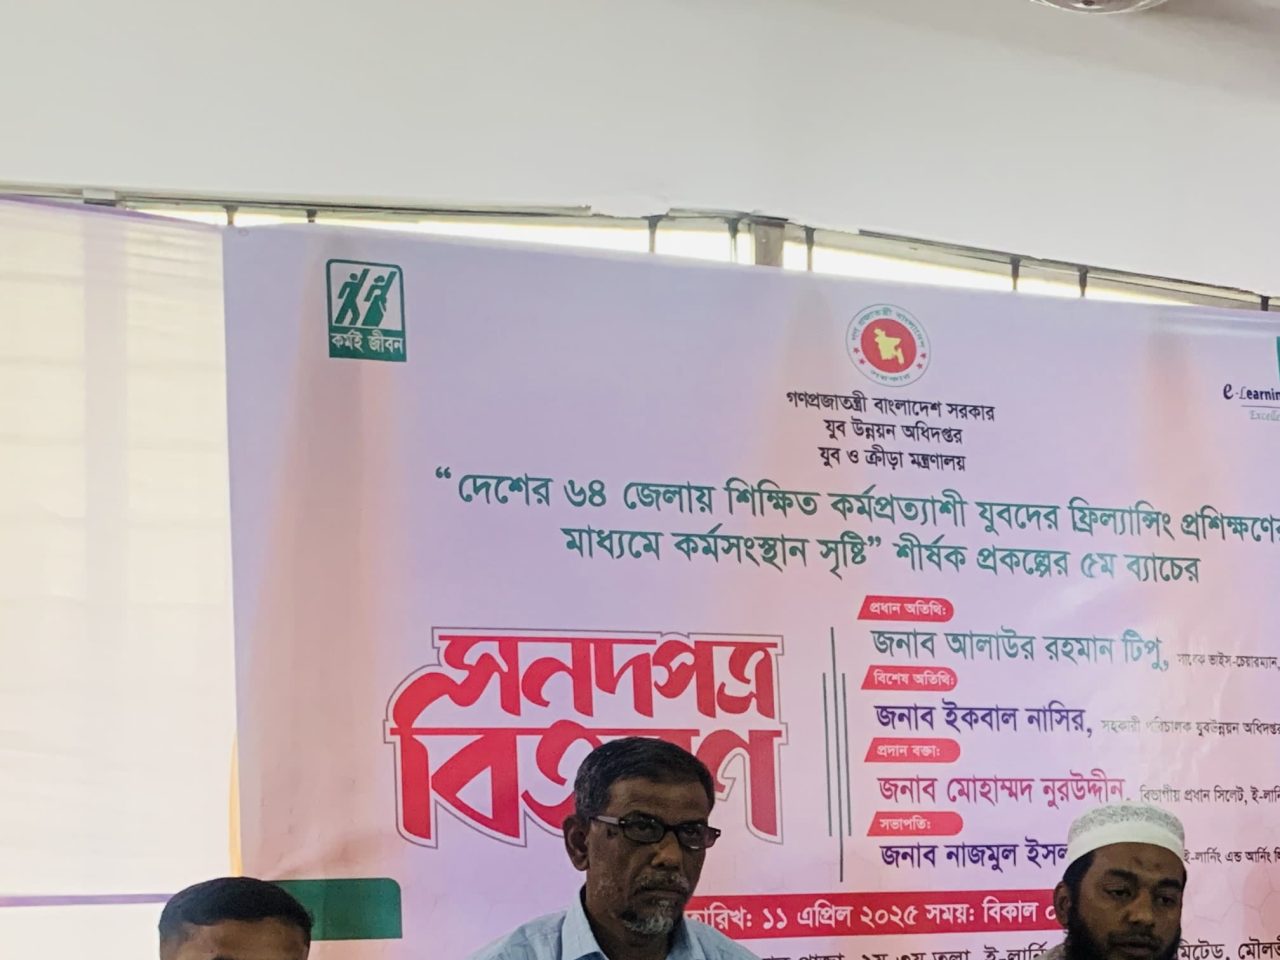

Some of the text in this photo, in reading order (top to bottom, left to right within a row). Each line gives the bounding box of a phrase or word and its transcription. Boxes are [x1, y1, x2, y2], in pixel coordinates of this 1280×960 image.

[330, 329, 403, 354] কর্মই জীবন
[786, 390, 995, 421] গণপ্রজাতন্ত্রী বাংলাদেশ সরকার
[824, 416, 962, 444] যুব উন্নয়ন অধিদপ্তর
[818, 444, 966, 472] যুব ও ক্রীড়া মন্ত্রণালয়
[564, 479, 606, 507] ৬৪
[624, 481, 715, 514] জেলায়
[724, 476, 821, 517] শিক্ষিত
[828, 484, 968, 527] কর্মপ্রত্যাশী
[976, 501, 1060, 536] যুবদের
[1067, 497, 1175, 540] ফ্রিল্যান্সিং
[560, 524, 663, 560] মাধ্যমে
[671, 523, 809, 572] কর্মসংস্থান
[893, 532, 968, 571] শীর্ষক
[977, 545, 1070, 578] প্রকল্পের
[1080, 551, 1117, 578] ৫ম
[1124, 553, 1201, 583] ব্যাচের
[870, 602, 901, 615] প্রধান
[870, 628, 937, 659] জনাব
[944, 625, 1036, 661] আলাউর
[1042, 635, 1116, 663] রহমান
[1121, 628, 1169, 671] টিপু,
[439, 634, 778, 720] সনদপত্র
[874, 671, 909, 686] বিশেষ
[874, 703, 936, 731] জনাব
[942, 698, 1019, 733] ইকবাল
[1025, 700, 1092, 738] নাসির,
[390, 672, 782, 840] বিতণ
[877, 774, 938, 803] জনাব
[946, 774, 1034, 806] মোহাম্মদ
[1184, 788, 1210, 802] প্রধান
[1214, 785, 1248, 806] সিলেট,
[880, 842, 938, 868] জনাব
[944, 842, 1019, 872] নাজমুল
[1245, 846, 1272, 864] আর্নিং
[762, 907, 788, 930] ১১
[797, 899, 854, 928] এপ্রিল
[860, 905, 918, 928] ২০২৫
[981, 896, 1039, 924] বিকাল
